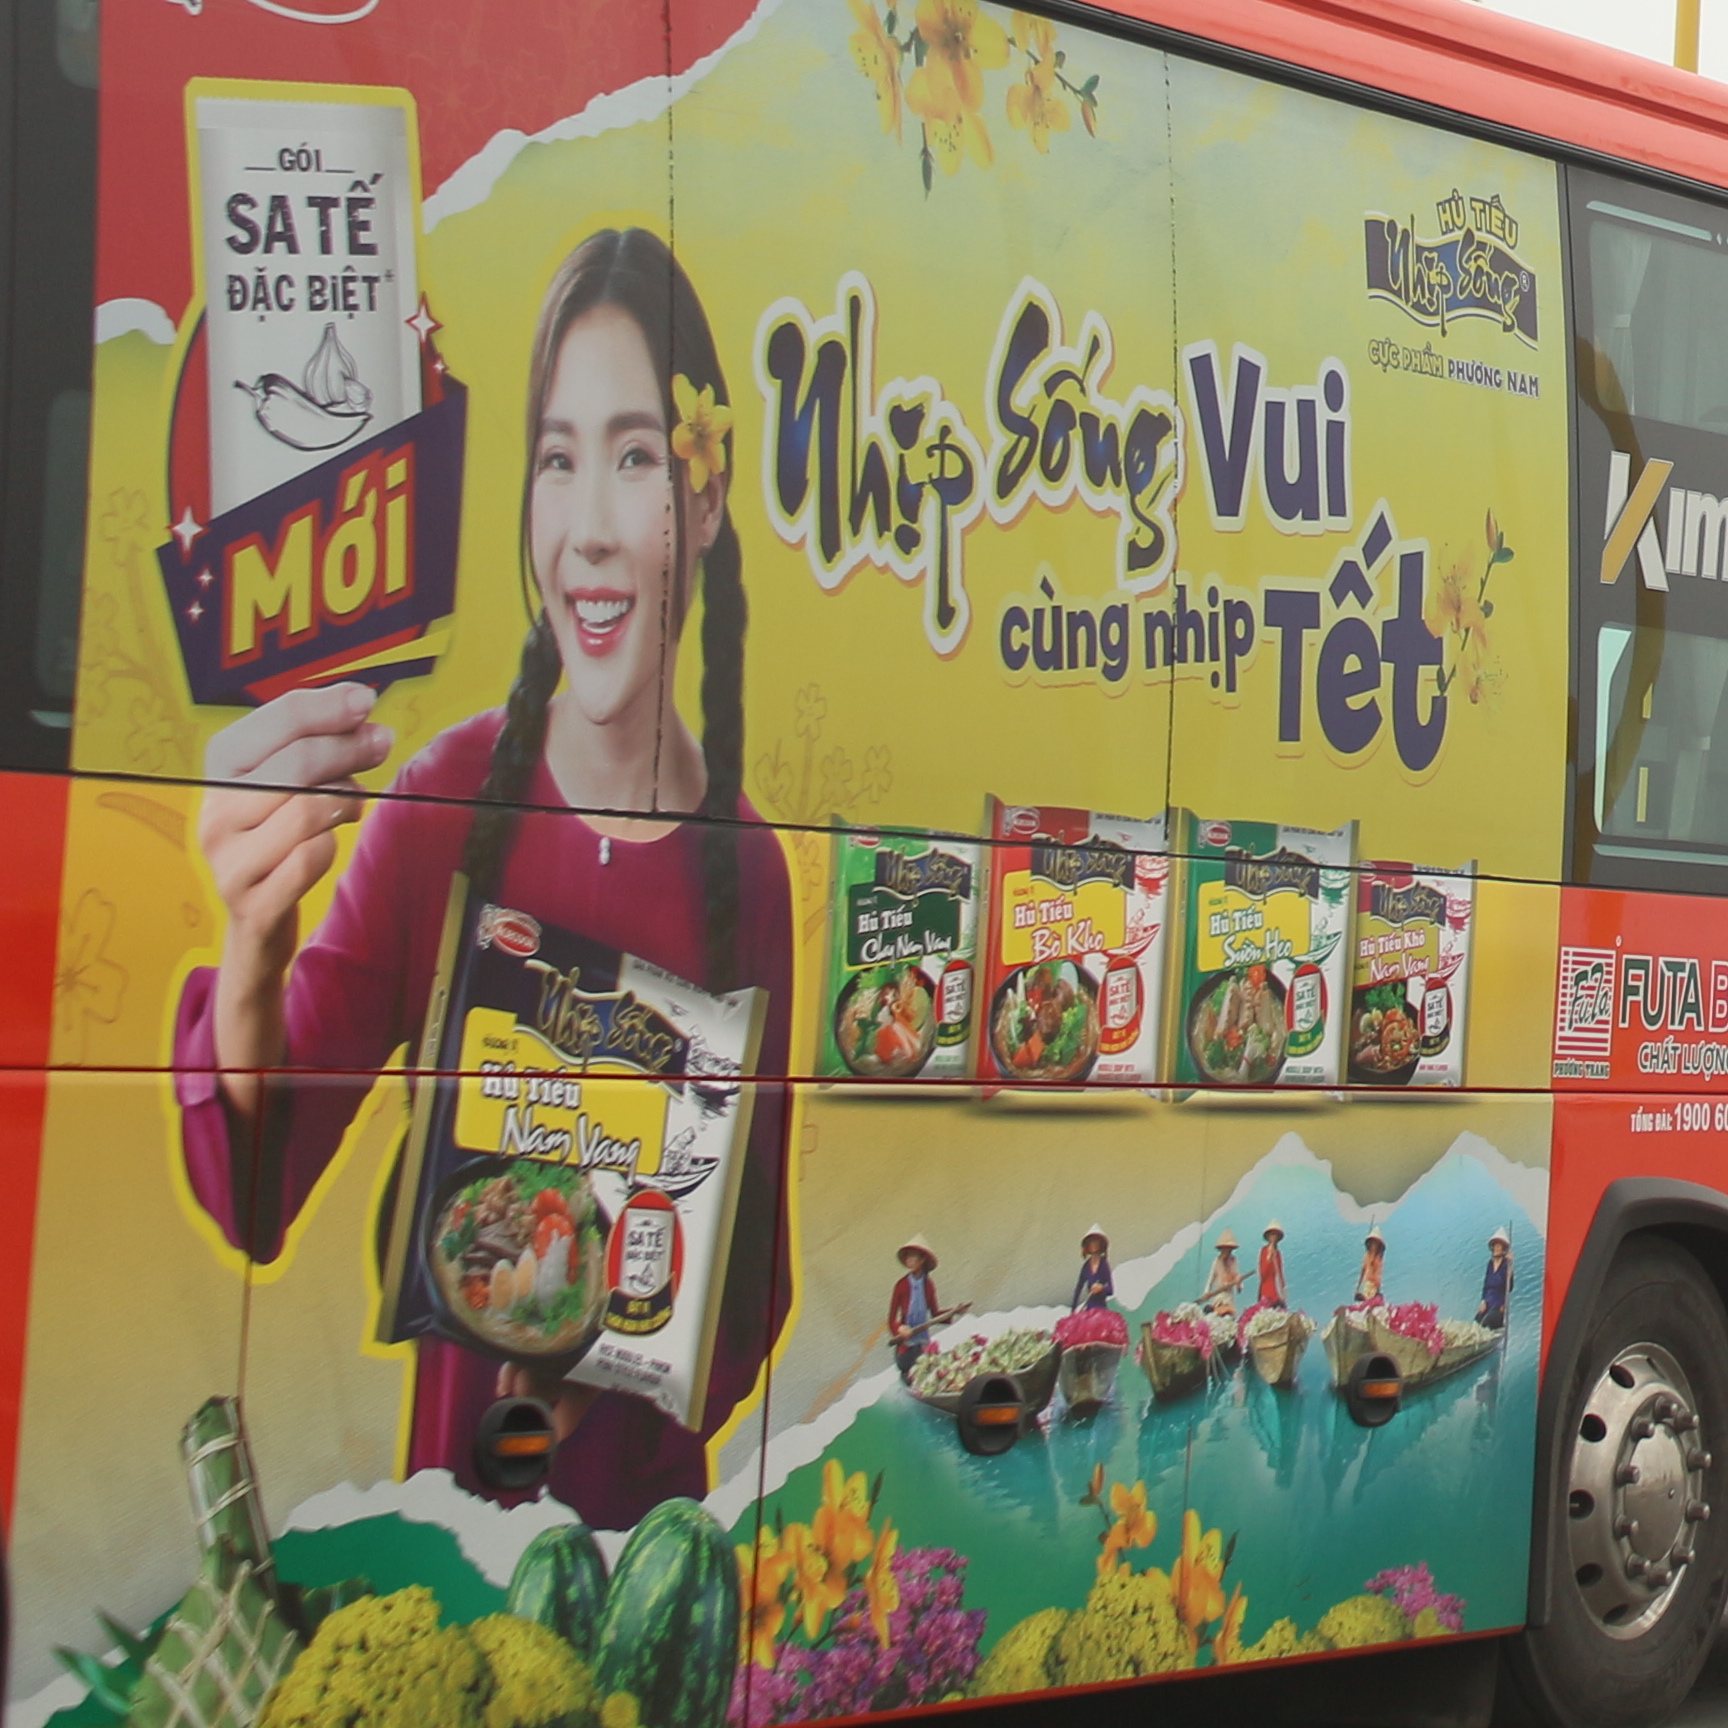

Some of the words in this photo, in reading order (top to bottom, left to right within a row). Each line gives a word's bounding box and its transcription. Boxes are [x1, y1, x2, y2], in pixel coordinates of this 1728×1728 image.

[278, 142, 323, 172] GÓI
[1436, 188, 1465, 235] HỦ
[1469, 194, 1519, 250] TIẾU
[226, 266, 296, 322] ĐẶC
[1368, 337, 1400, 372] CỰC
[1448, 358, 1502, 390] PHƯƠNG
[1507, 371, 1539, 398] NAM
[766, 292, 974, 630] Nhịp
[998, 300, 1172, 572] Sống
[1188, 352, 1349, 522] Vui
[229, 456, 408, 658] Mới
[1000, 577, 1130, 684] cùng
[1144, 585, 1255, 694] nhịp
[1263, 511, 1448, 772] Tết
[857, 910, 879, 934] Hủ
[880, 904, 913, 931] Tiếu
[1014, 901, 1036, 929] Hủ
[1039, 893, 1073, 924] Tiếu
[1209, 909, 1230, 937] Hủ
[1232, 902, 1264, 933] Tiếu
[1032, 927, 1062, 964] Bò
[1066, 917, 1105, 956] Kho
[1265, 926, 1293, 960] Heo
[1618, 954, 1705, 1032] FUTA
[1637, 1035, 1681, 1074] CHẤT
[1630, 1106, 1654, 1133] TỔNG
[1674, 1103, 1711, 1131] 1900
[501, 1103, 573, 1164] Nam
[576, 1111, 642, 1189] Vang
